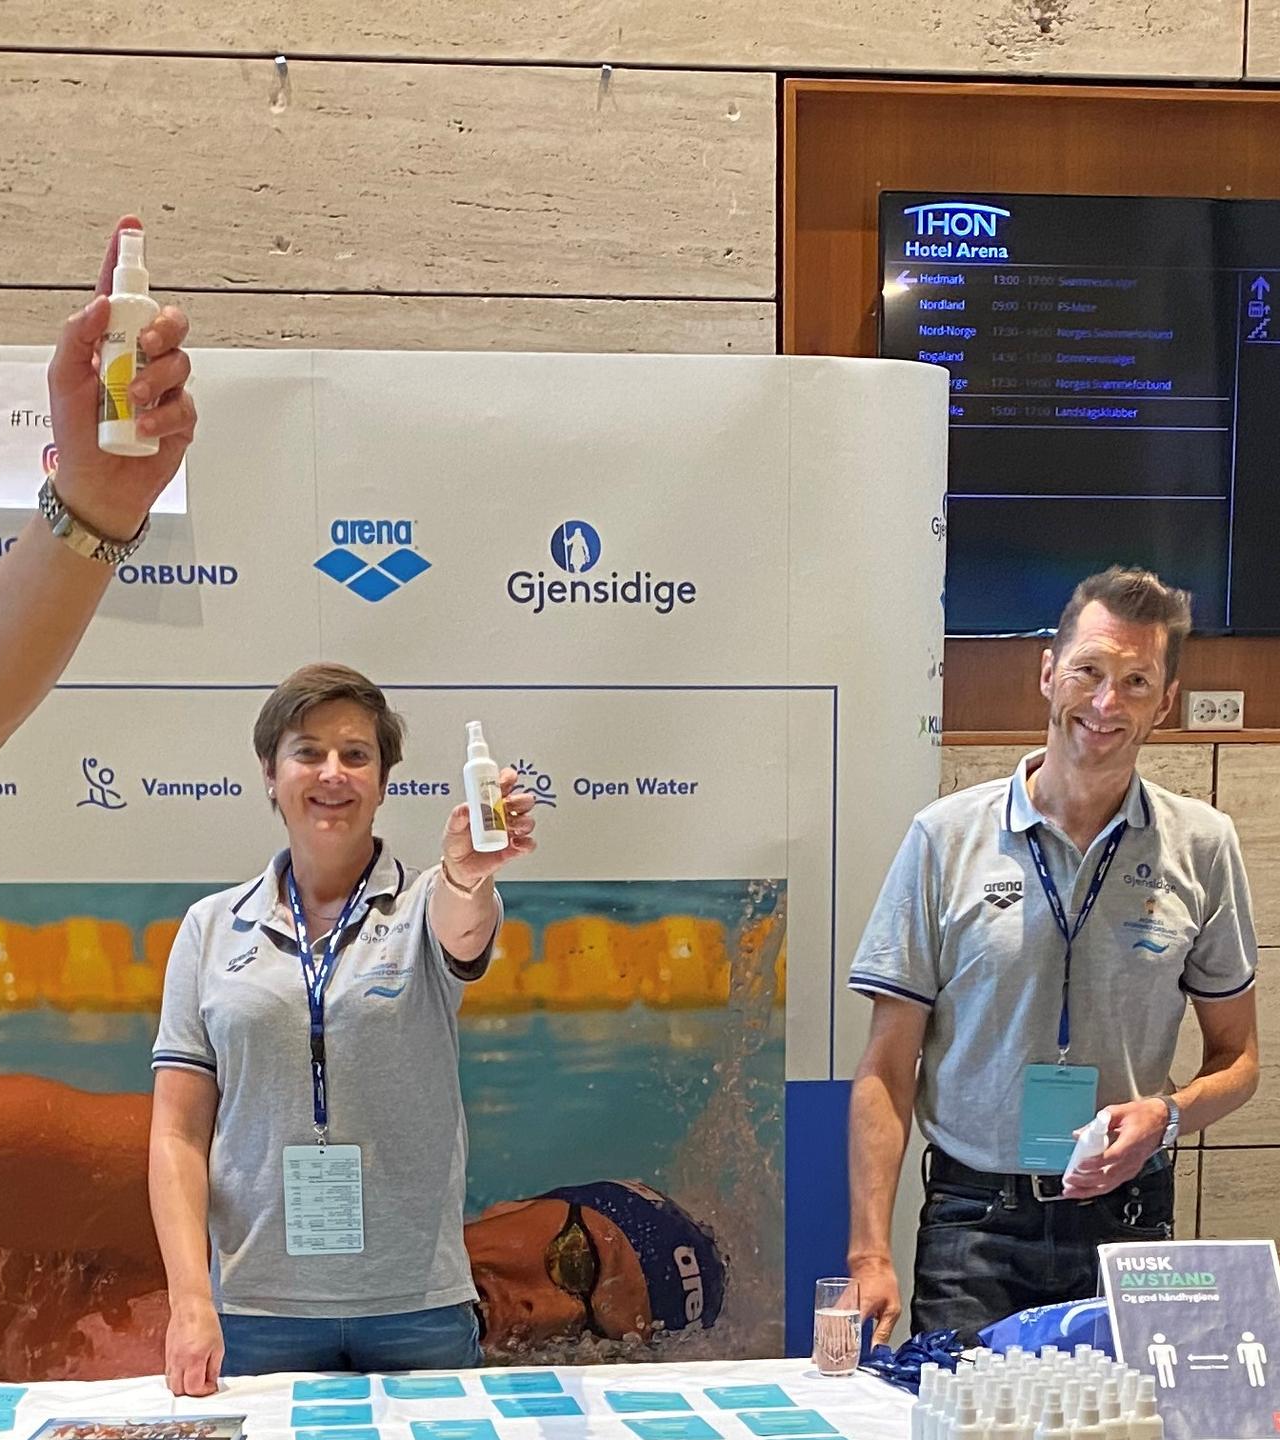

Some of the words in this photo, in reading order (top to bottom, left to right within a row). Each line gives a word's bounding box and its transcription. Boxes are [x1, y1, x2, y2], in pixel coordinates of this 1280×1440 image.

[904, 202, 1010, 238] THON
[905, 241, 951, 259] Hotel
[956, 242, 1009, 260] Arena
[919, 273, 965, 286] Hedmark
[919, 299, 965, 311] Nordland
[919, 325, 977, 340] Nord-Norge
[918, 351, 964, 364] Rogaland
[11, 409, 52, 427] #Tre
[331, 519, 413, 546] arena
[507, 570, 697, 614] Gjensidige
[141, 777, 242, 800] Vannpolo
[385, 778, 451, 797] asters
[573, 777, 629, 799] Open
[635, 777, 699, 796] Water
[984, 881, 1022, 892] arena
[1117, 1257, 1172, 1271] HUSK
[674, 1245, 703, 1321] are
[1120, 1272, 1216, 1286] AVSTAND
[1122, 1293, 1138, 1304] Og
